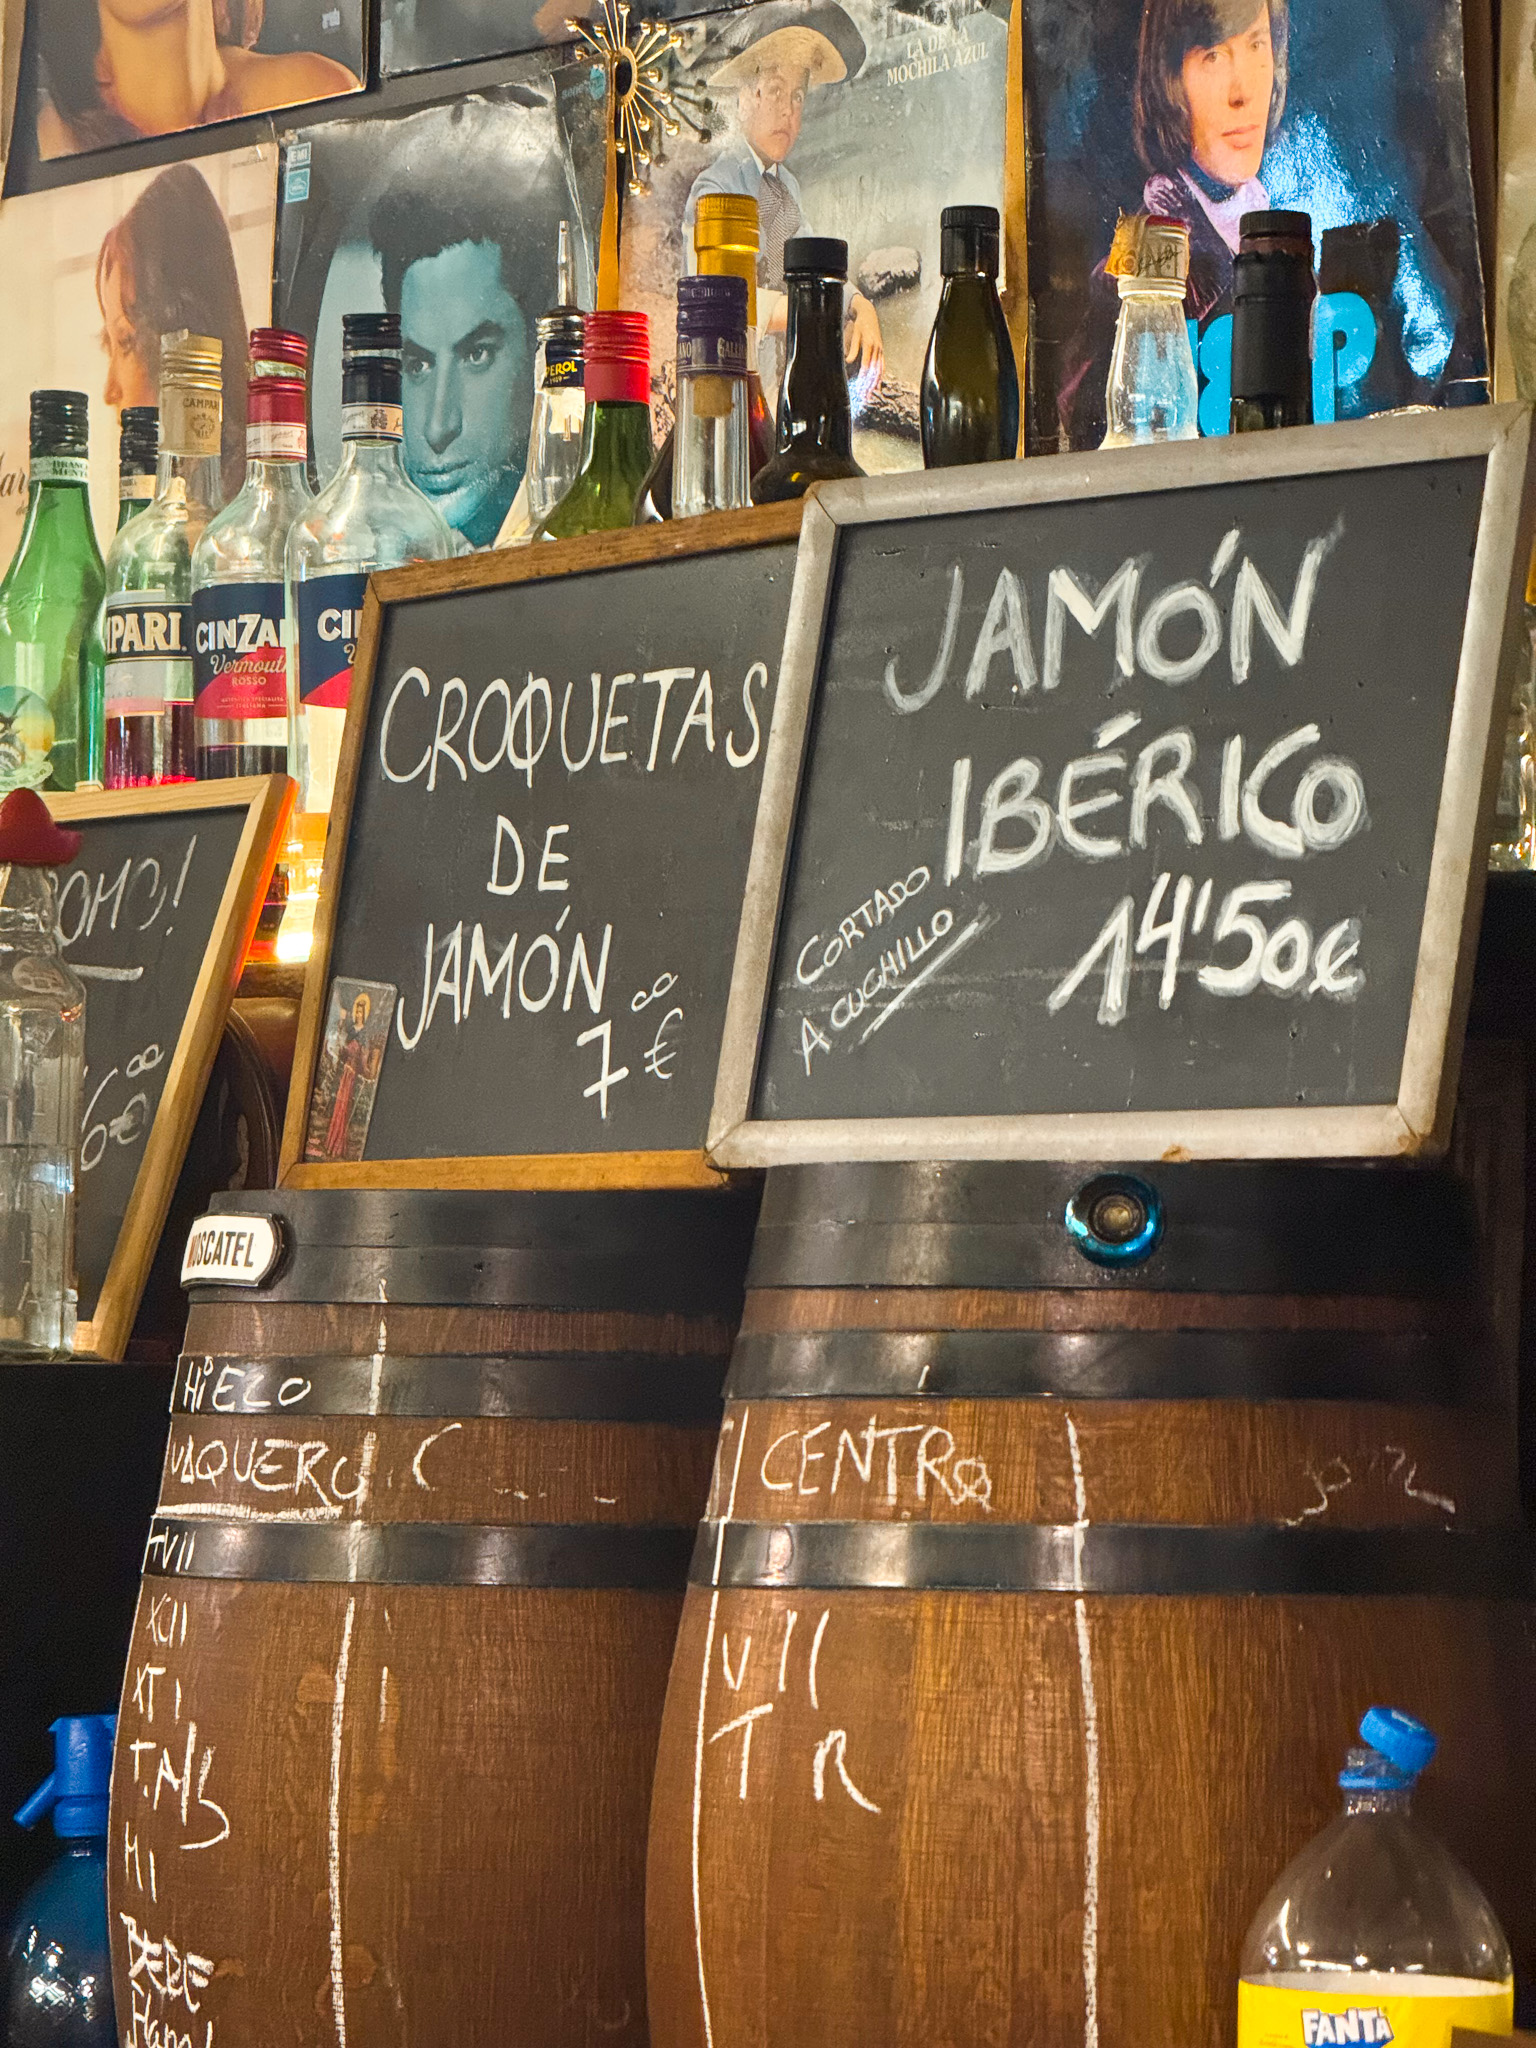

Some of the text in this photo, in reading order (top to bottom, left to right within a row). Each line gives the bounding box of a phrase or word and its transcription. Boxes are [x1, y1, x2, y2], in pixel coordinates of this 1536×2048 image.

[886, 41, 989, 87] MOCHILA AZUL
[885, 518, 1342, 713] JAMÓN
[231, 676, 267, 688] ROSSO
[379, 661, 769, 792] CROQUETAS
[486, 814, 570, 896] DE
[944, 709, 1368, 887] IBÉRICO
[396, 904, 614, 1051] JAMÓN
[796, 865, 931, 986] CORTADO
[802, 908, 954, 1077] A CUCHILLO
[1301, 2006, 1395, 2048] FANTA
